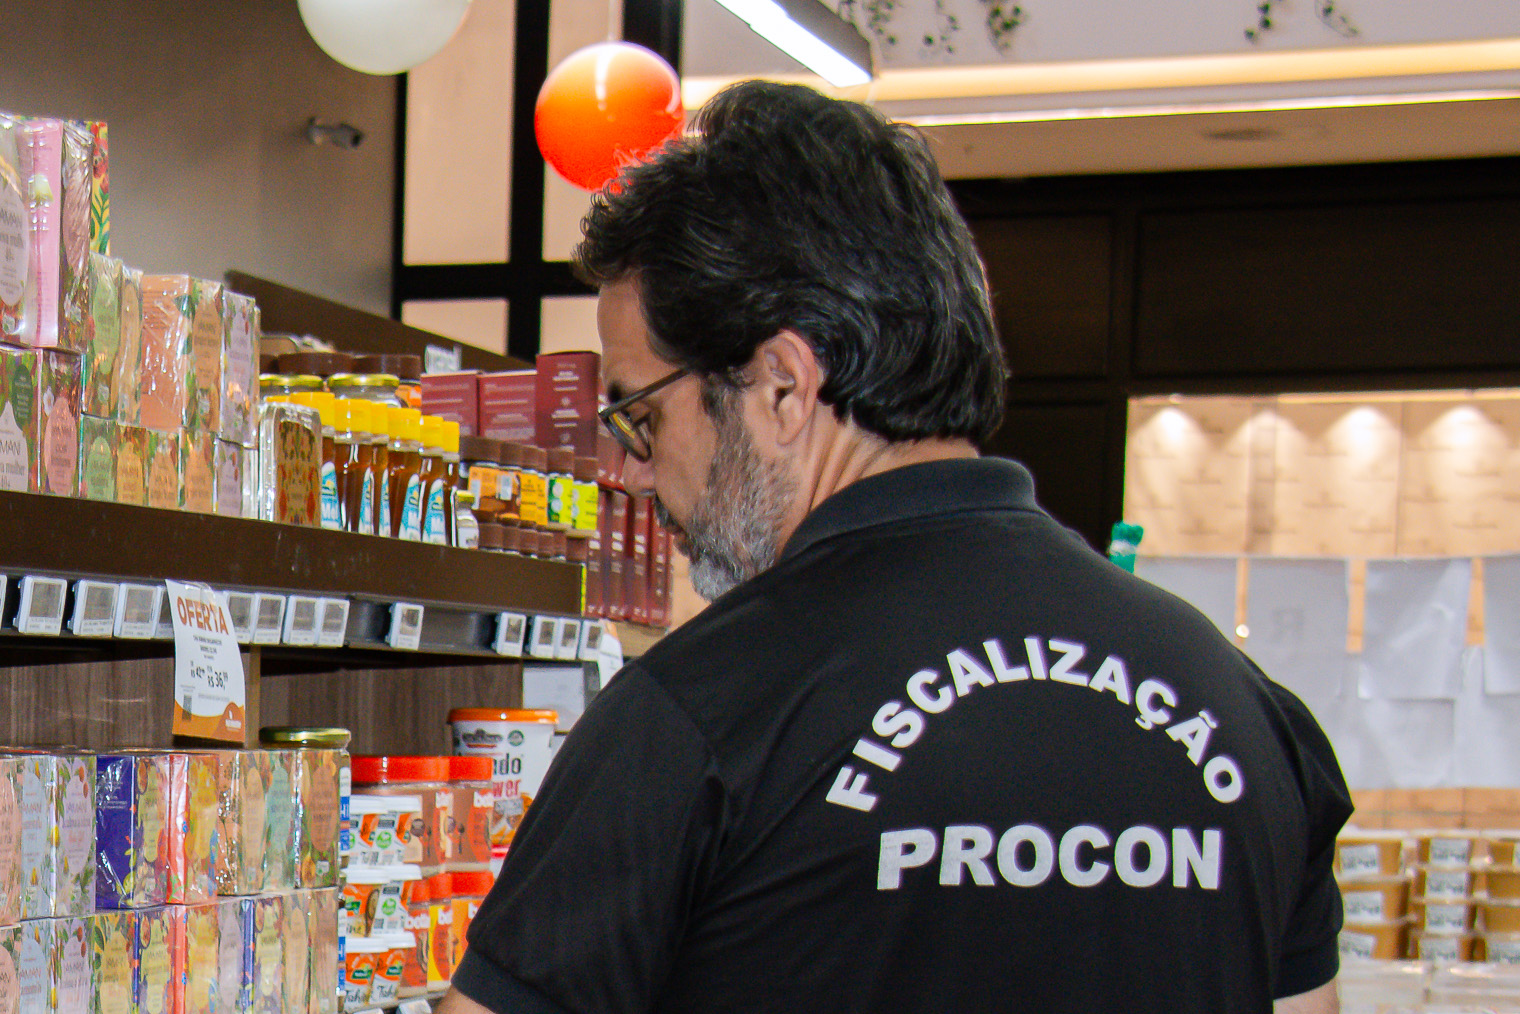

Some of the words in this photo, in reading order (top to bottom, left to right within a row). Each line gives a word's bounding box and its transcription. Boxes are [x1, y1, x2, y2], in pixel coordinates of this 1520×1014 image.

[177, 596, 229, 635] OFERTA
[825, 637, 1244, 813] FISCALIZAÇÃO
[876, 824, 1221, 890] PROCON
